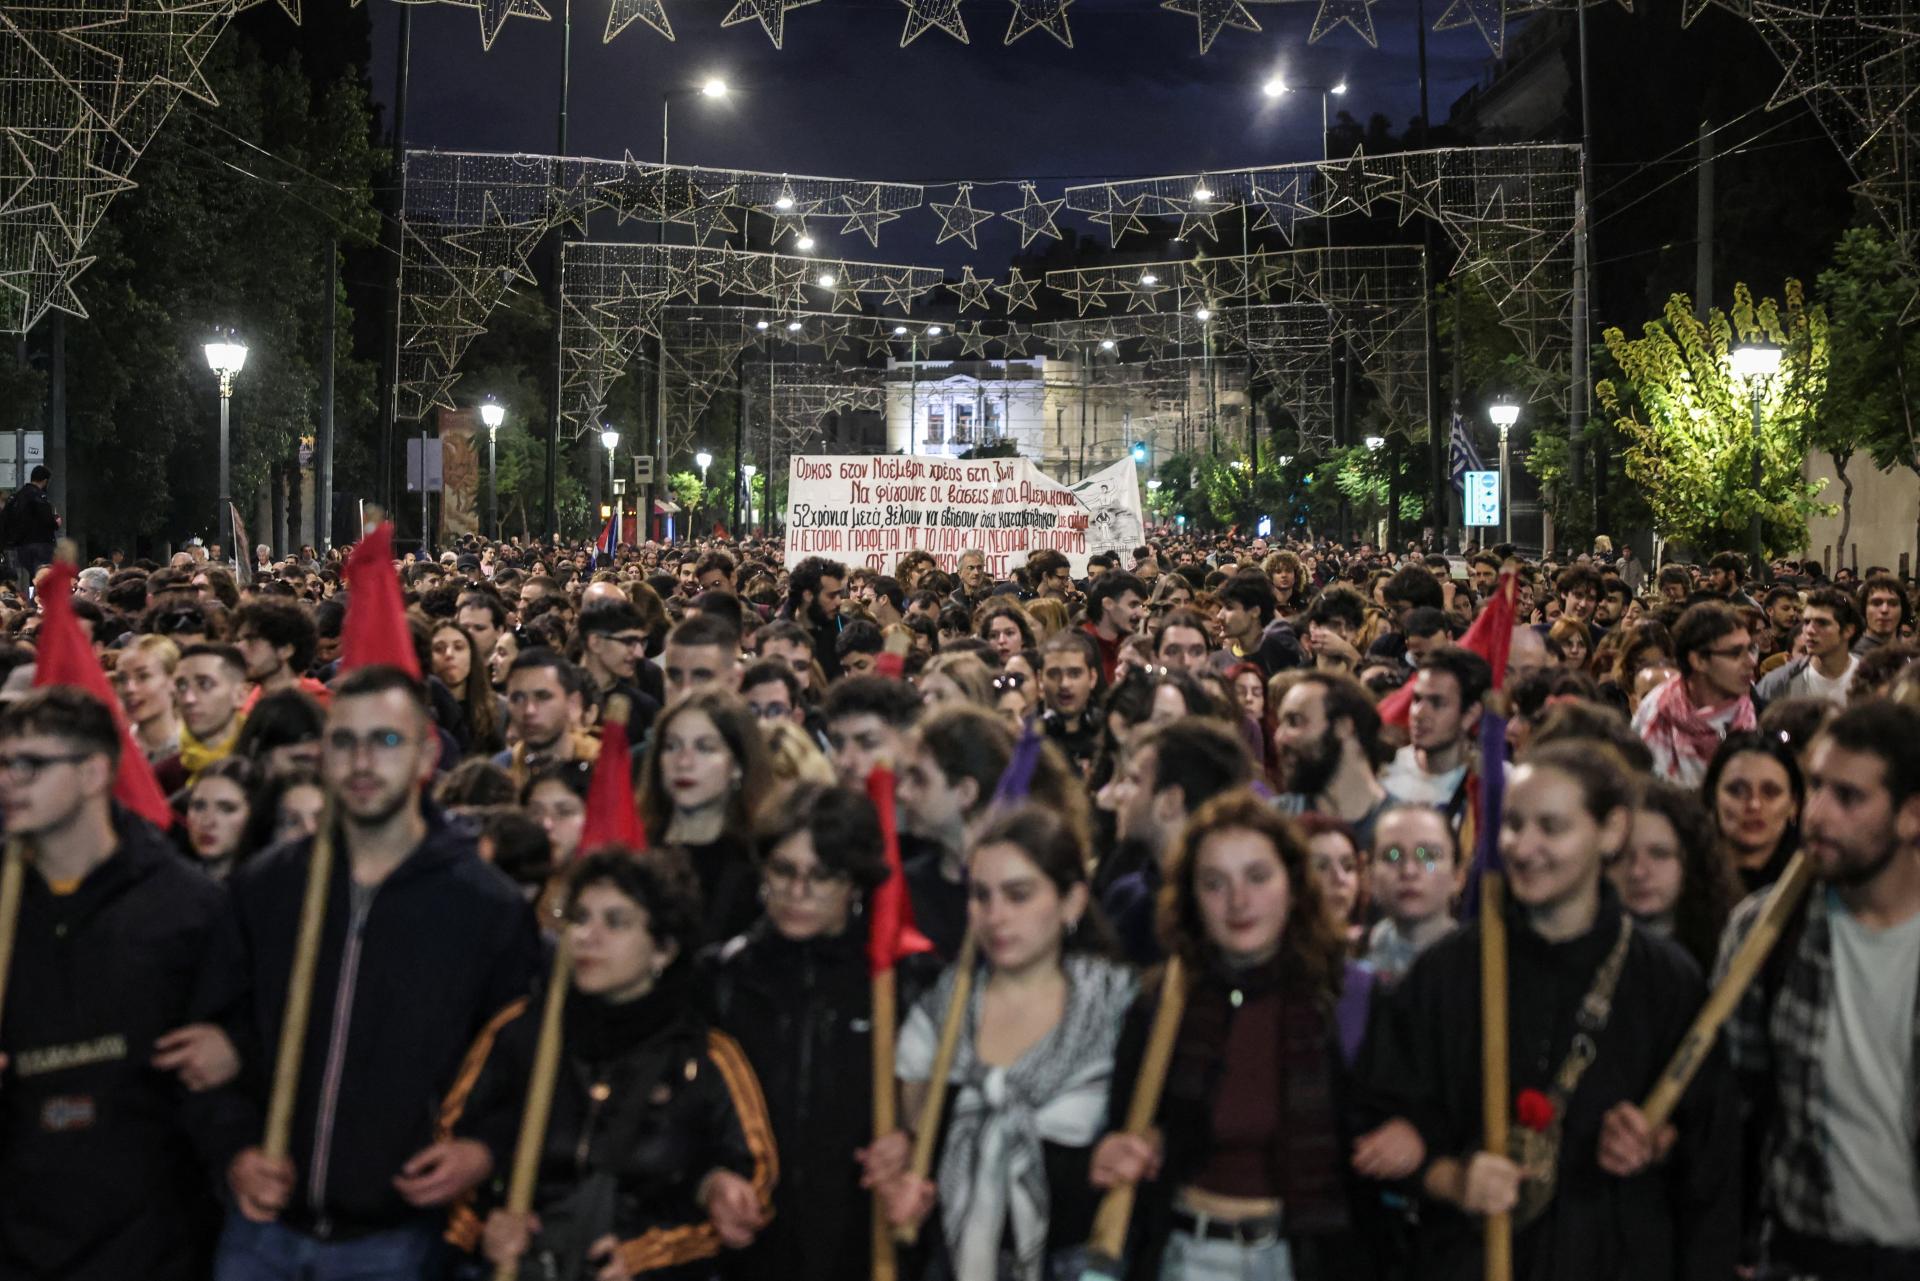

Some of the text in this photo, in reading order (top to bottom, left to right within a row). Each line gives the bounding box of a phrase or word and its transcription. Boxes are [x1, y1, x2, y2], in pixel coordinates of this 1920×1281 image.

[840, 463, 868, 479] στον
[873, 457, 925, 480] Νοέμβρη
[929, 462, 962, 481] χρέος
[967, 467, 991, 482] στη
[850, 479, 870, 504] Να
[876, 482, 927, 504] φύγουνε
[930, 485, 942, 503] οι
[947, 484, 988, 504] βάσεις
[991, 489, 1004, 505] και
[1005, 487, 1018, 503] οι
[926, 510, 938, 527] να
[980, 509, 996, 528] όσα
[791, 529, 799, 551] Η
[801, 529, 843, 552] ΙΣΤΟΡΙΑ
[848, 528, 900, 552] ΓΡΑΦΕΤΑΙ
[905, 526, 921, 550] ΜΕ
[924, 527, 936, 551] ΤΟ
[938, 527, 959, 551] ΛΑΟ
[988, 528, 1029, 553] ΝΕΟΛΑΙΑ
